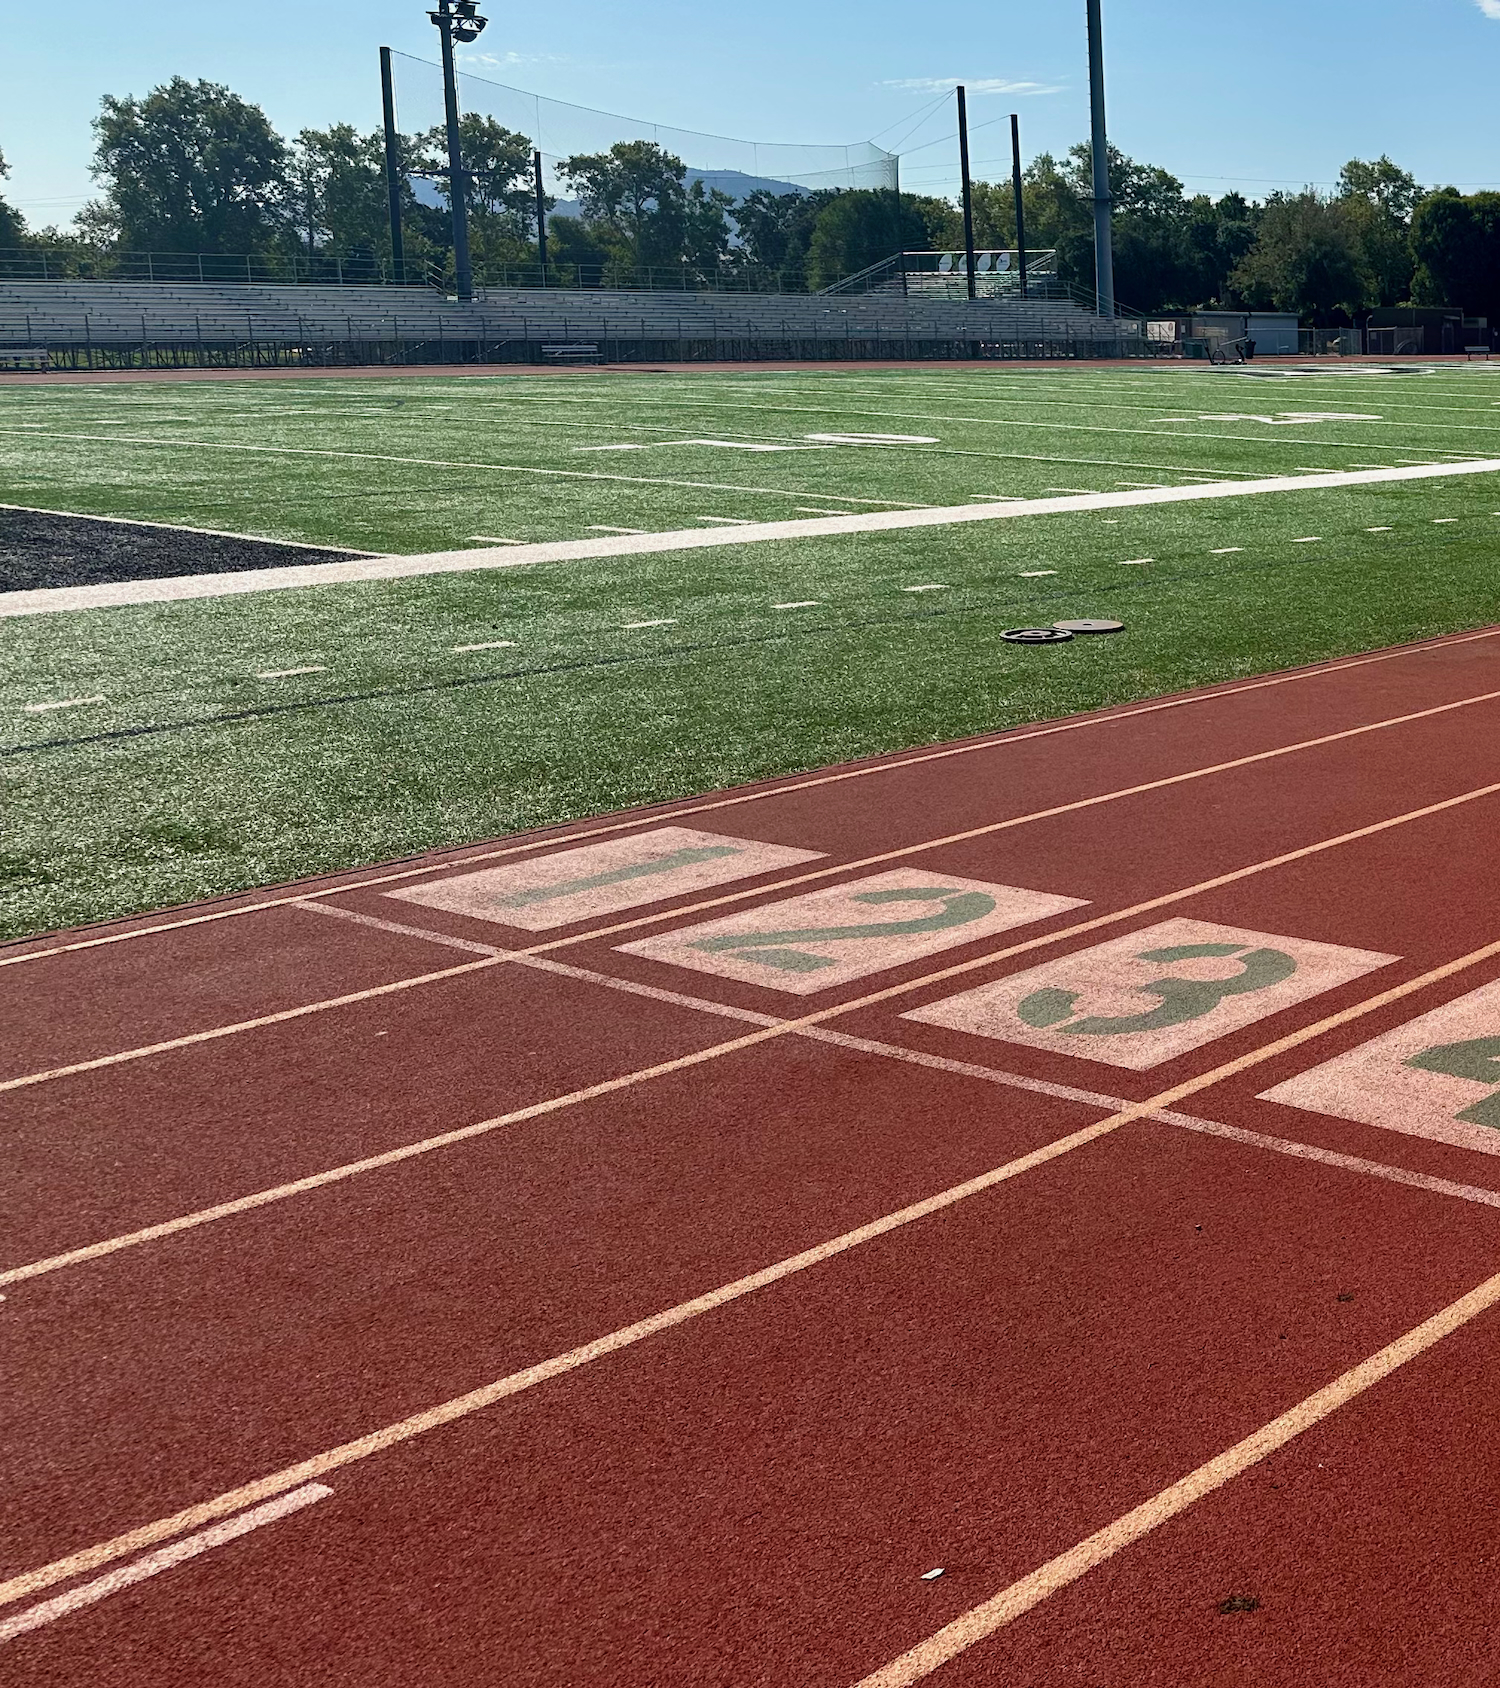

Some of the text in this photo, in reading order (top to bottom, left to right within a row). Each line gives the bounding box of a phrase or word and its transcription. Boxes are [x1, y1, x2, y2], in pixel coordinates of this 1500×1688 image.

[492, 844, 744, 909] 1
[685, 886, 996, 973] 2
[1017, 943, 1298, 1035] 3
